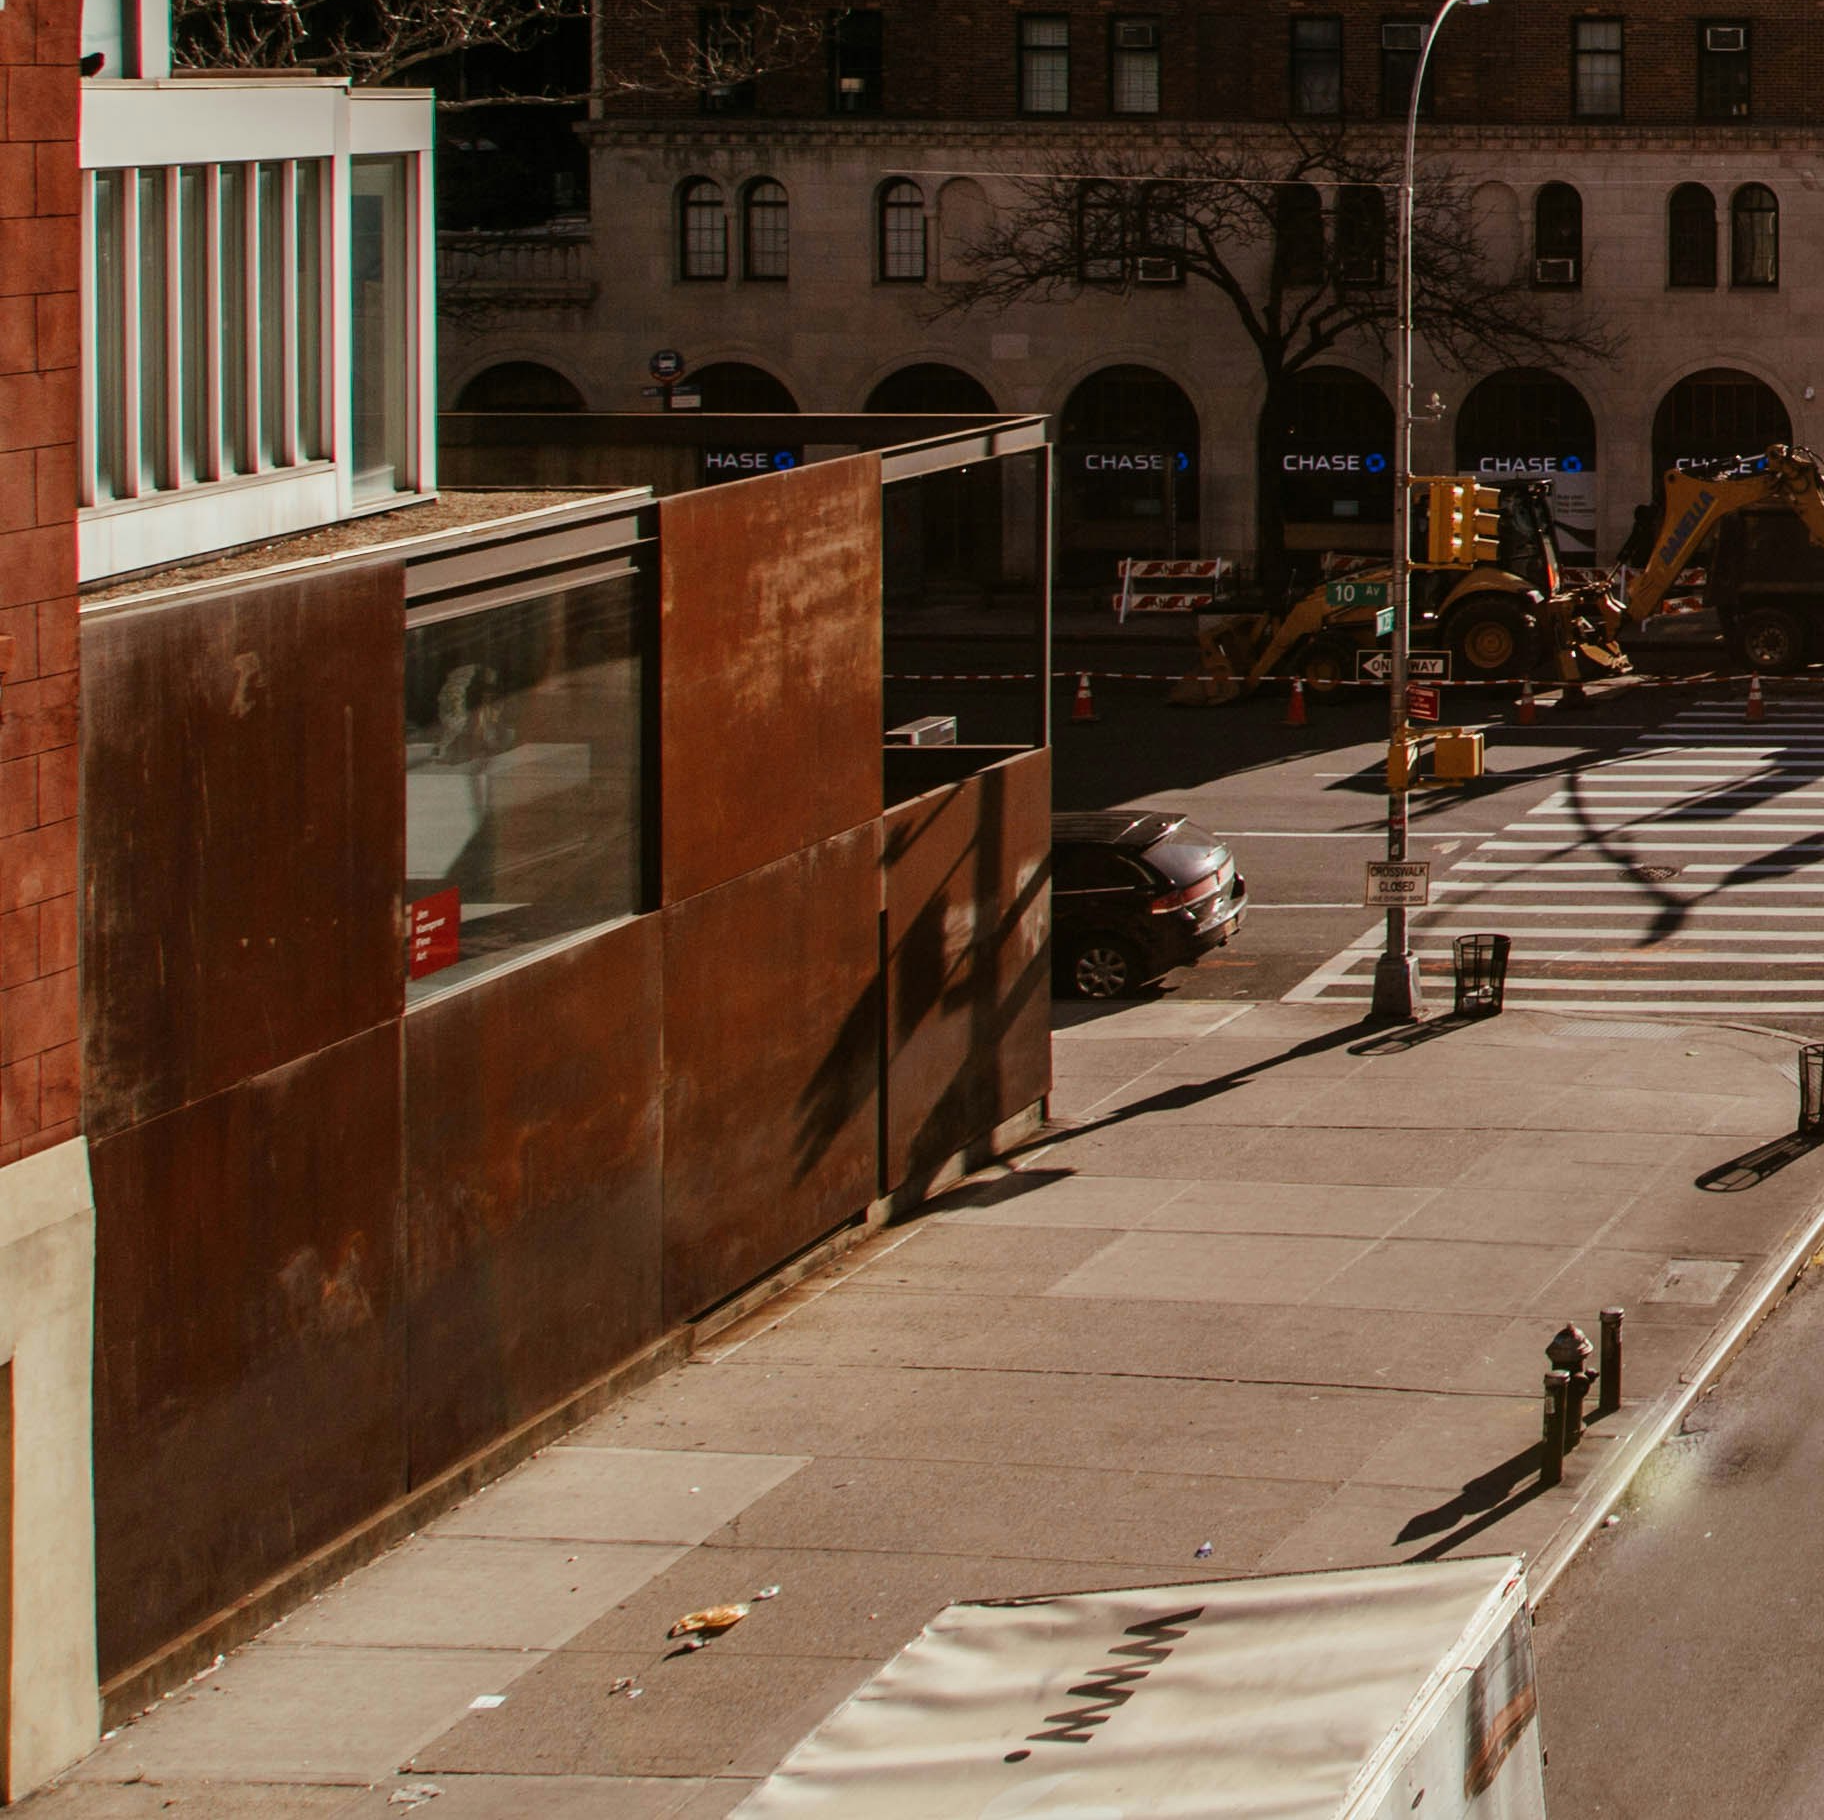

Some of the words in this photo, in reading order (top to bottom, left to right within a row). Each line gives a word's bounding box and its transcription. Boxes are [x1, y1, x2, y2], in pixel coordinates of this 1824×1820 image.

[706, 452, 768, 469] HASE
[1085, 454, 1164, 470] CHASE
[1283, 454, 1361, 471] CHASE
[1480, 457, 1557, 472] CHASE
[1676, 458, 1753, 474] CHE
[1335, 584, 1355, 602] 10
[1366, 585, 1381, 595] Av
[1371, 659, 1392, 671] ON
[1410, 659, 1438, 671] WAY
[1370, 866, 1426, 877] CROSSWALK
[1379, 881, 1415, 892] CLOSED
